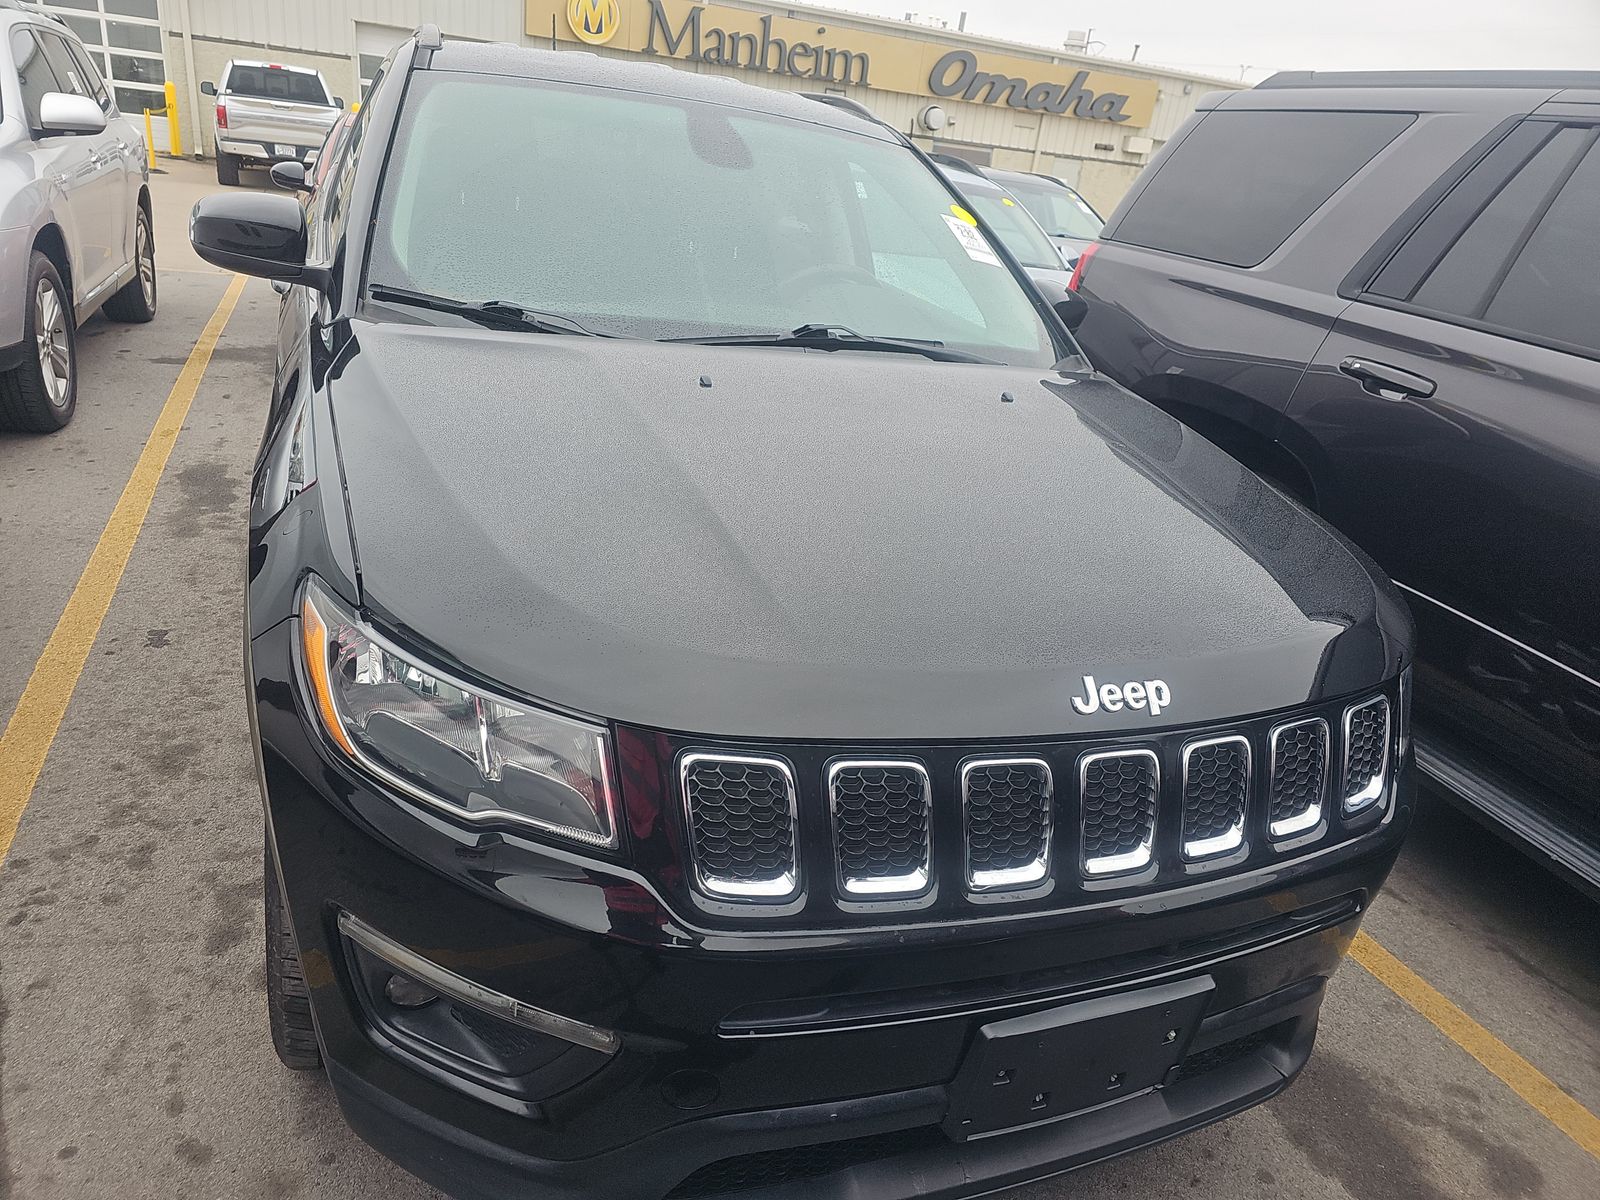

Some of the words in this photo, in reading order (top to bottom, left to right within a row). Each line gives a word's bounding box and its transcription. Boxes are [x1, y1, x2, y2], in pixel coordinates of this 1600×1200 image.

[575, 0, 614, 37] M
[642, 0, 871, 87] Manheim
[929, 50, 1132, 122] Omaha
[1071, 675, 1172, 717] Jeep
